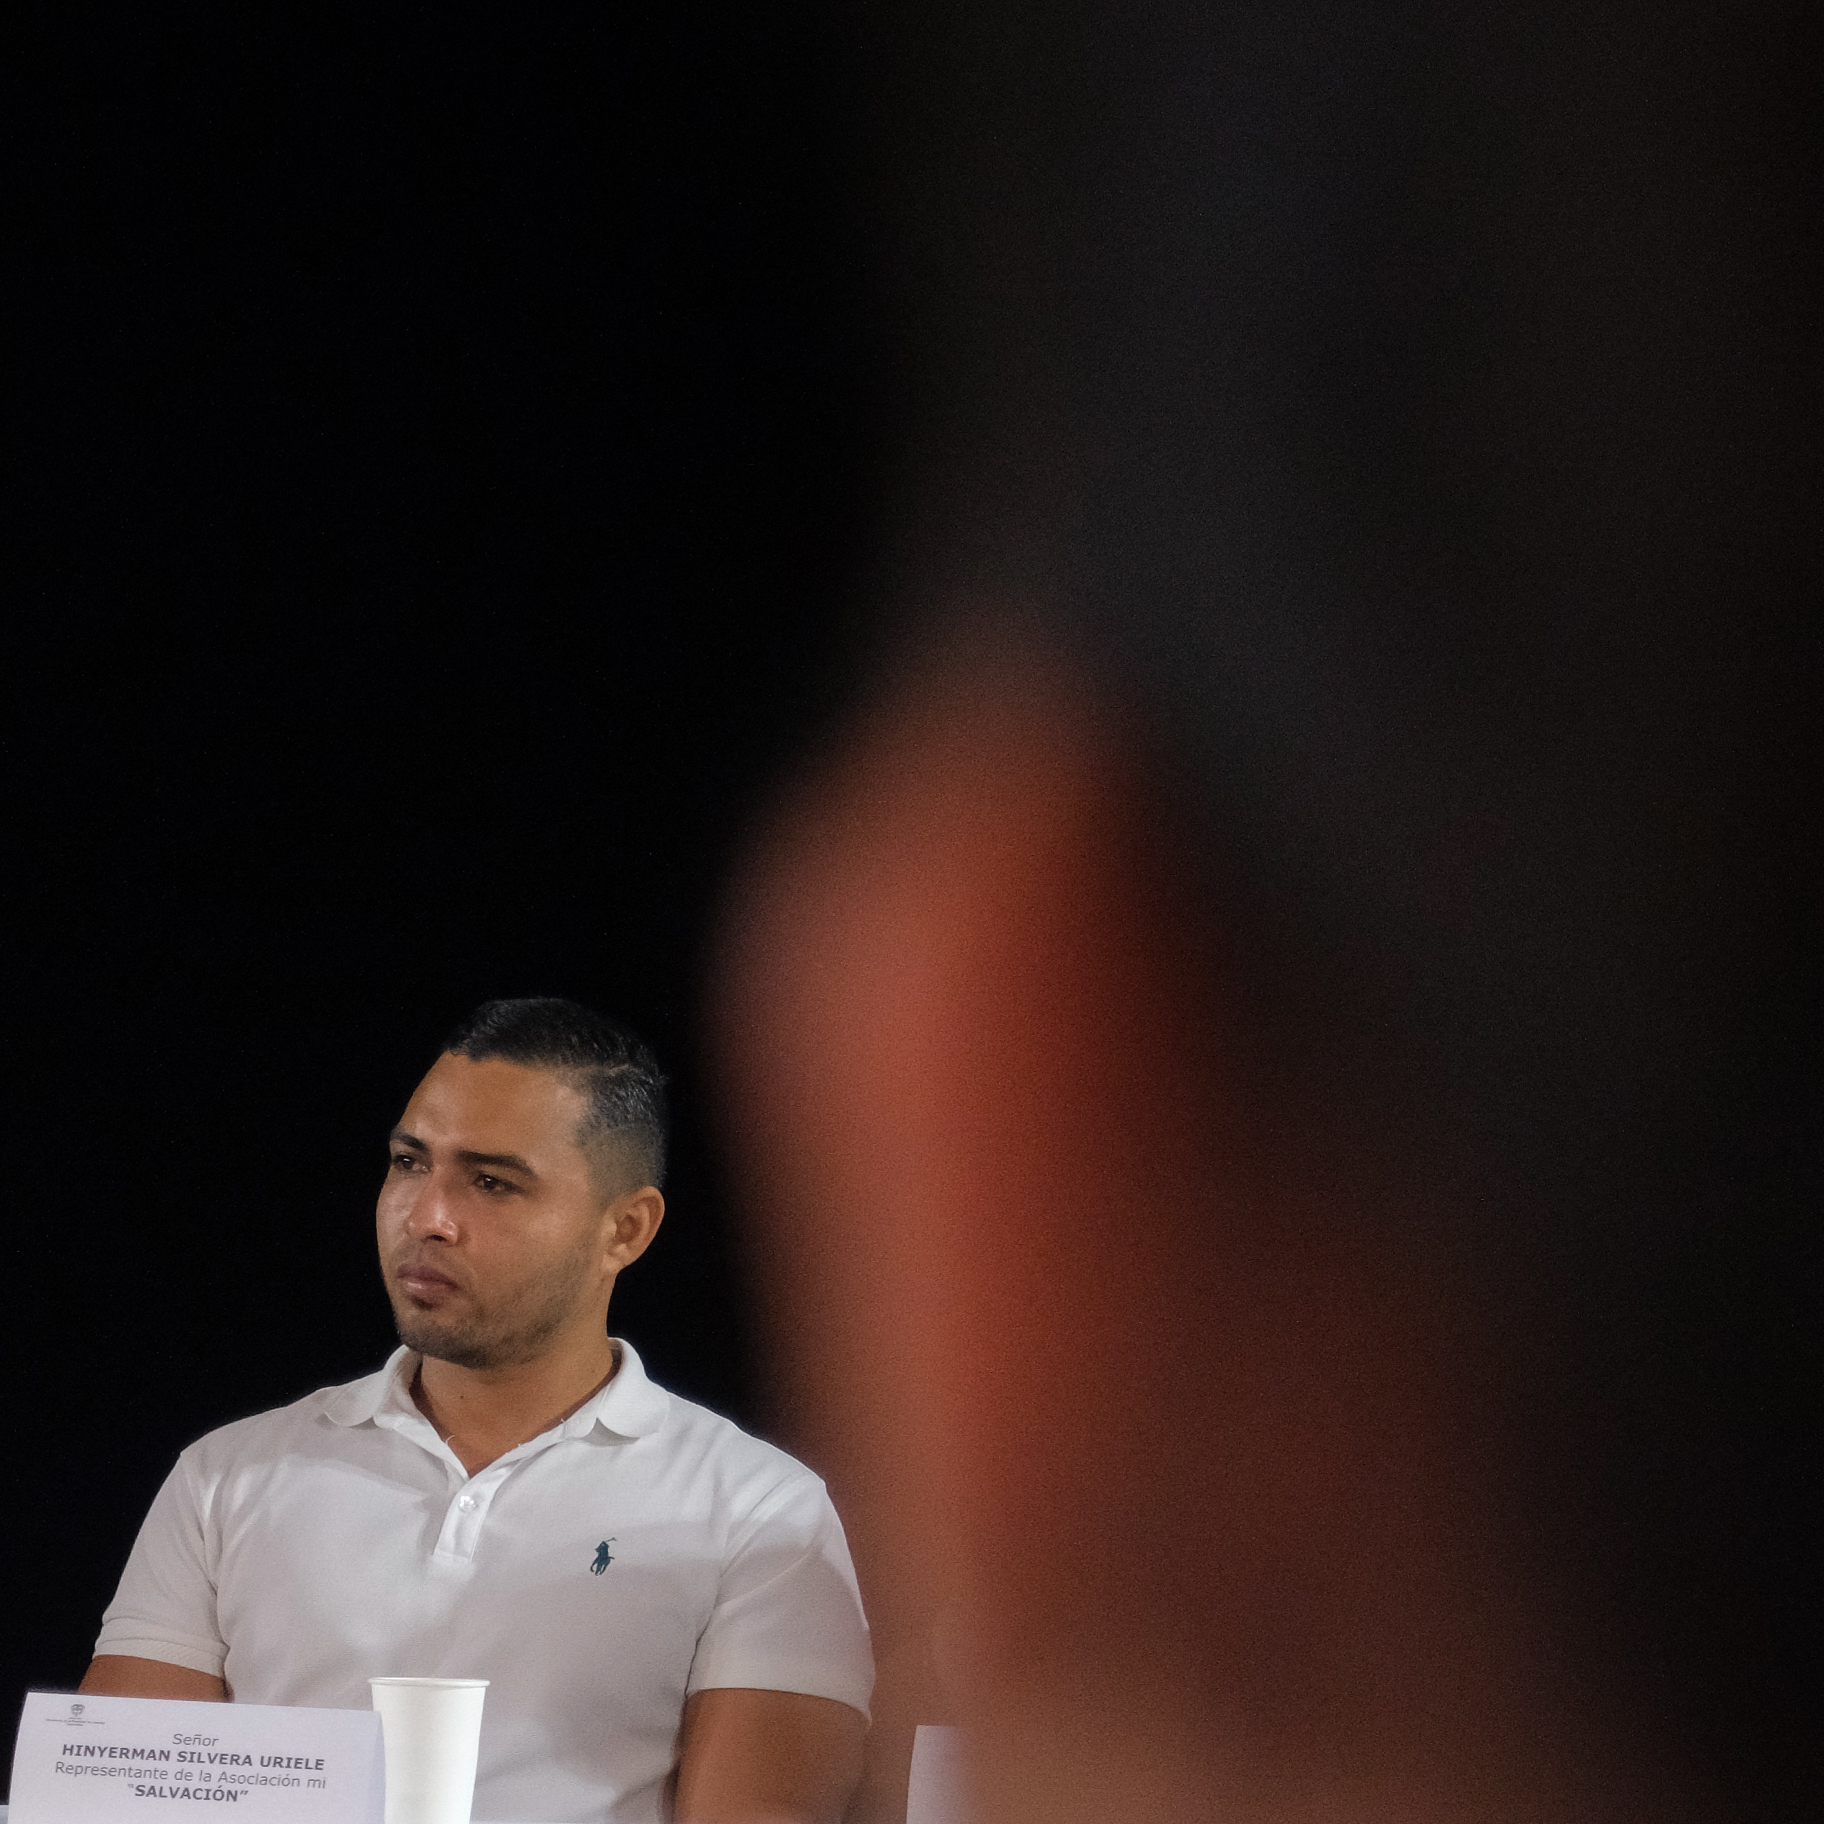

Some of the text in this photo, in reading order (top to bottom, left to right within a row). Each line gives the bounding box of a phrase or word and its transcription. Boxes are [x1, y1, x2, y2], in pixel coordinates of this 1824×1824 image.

[173, 1733, 219, 1747] Señor
[62, 1743, 325, 1771] HINYERMAN SILVERA URIELE
[55, 1761, 326, 1789] Representante de la Asociación mi
